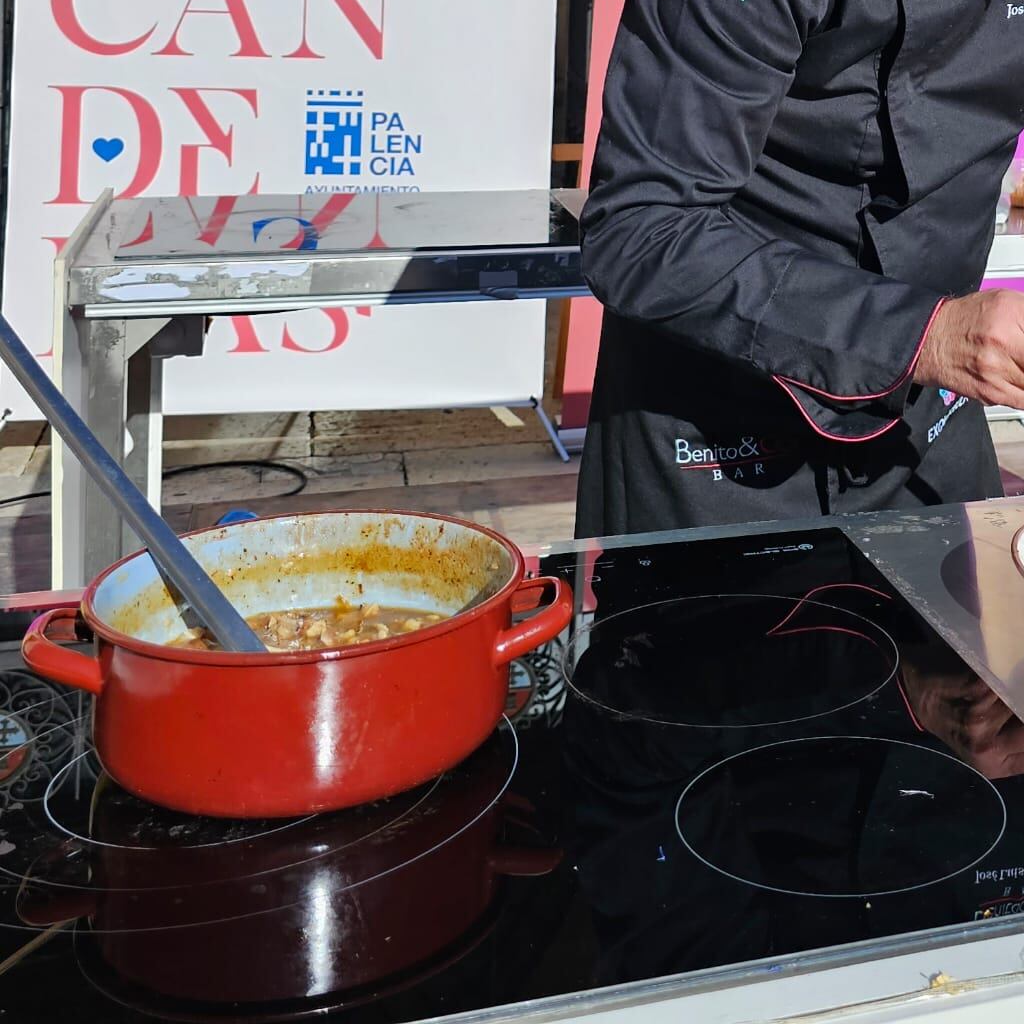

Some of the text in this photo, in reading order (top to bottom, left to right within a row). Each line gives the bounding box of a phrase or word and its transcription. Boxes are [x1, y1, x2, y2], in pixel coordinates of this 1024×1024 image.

[371, 112, 404, 131] PA
[42, 85, 260, 204] DE
[370, 134, 422, 154] LEN
[369, 157, 415, 176] CIA
